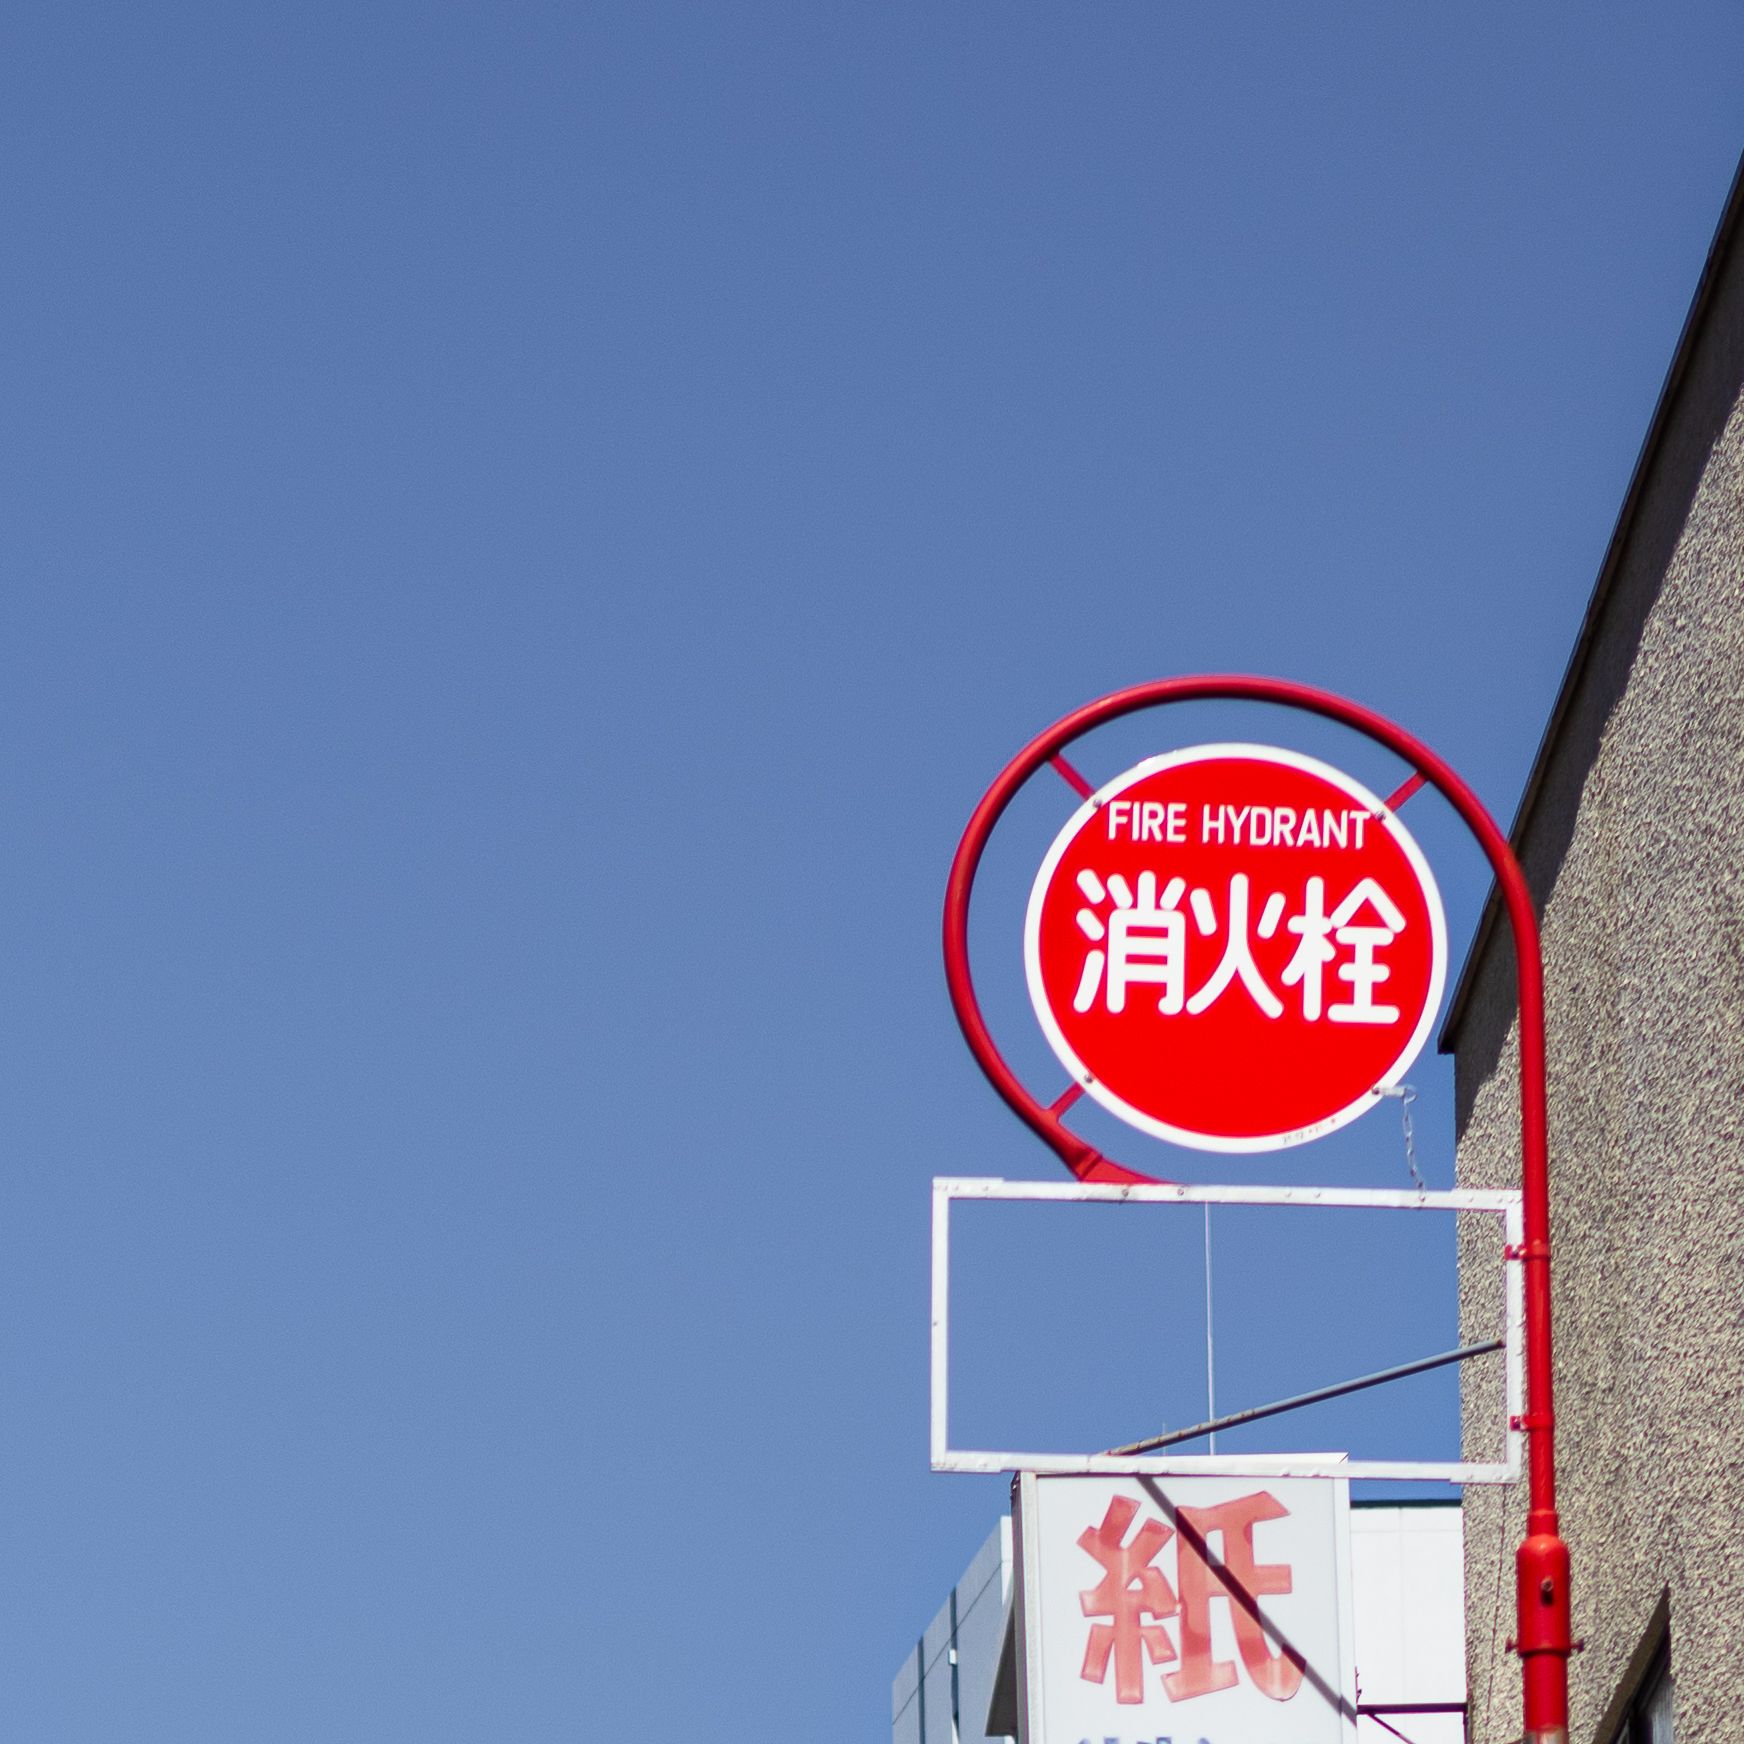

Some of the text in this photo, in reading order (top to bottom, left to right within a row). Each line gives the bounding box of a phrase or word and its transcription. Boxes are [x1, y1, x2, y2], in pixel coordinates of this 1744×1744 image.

[1107, 799, 1373, 850] FIRE HYDRANT
[1072, 868, 1407, 1024] 消火栓
[1076, 1489, 1308, 1705] 紙
